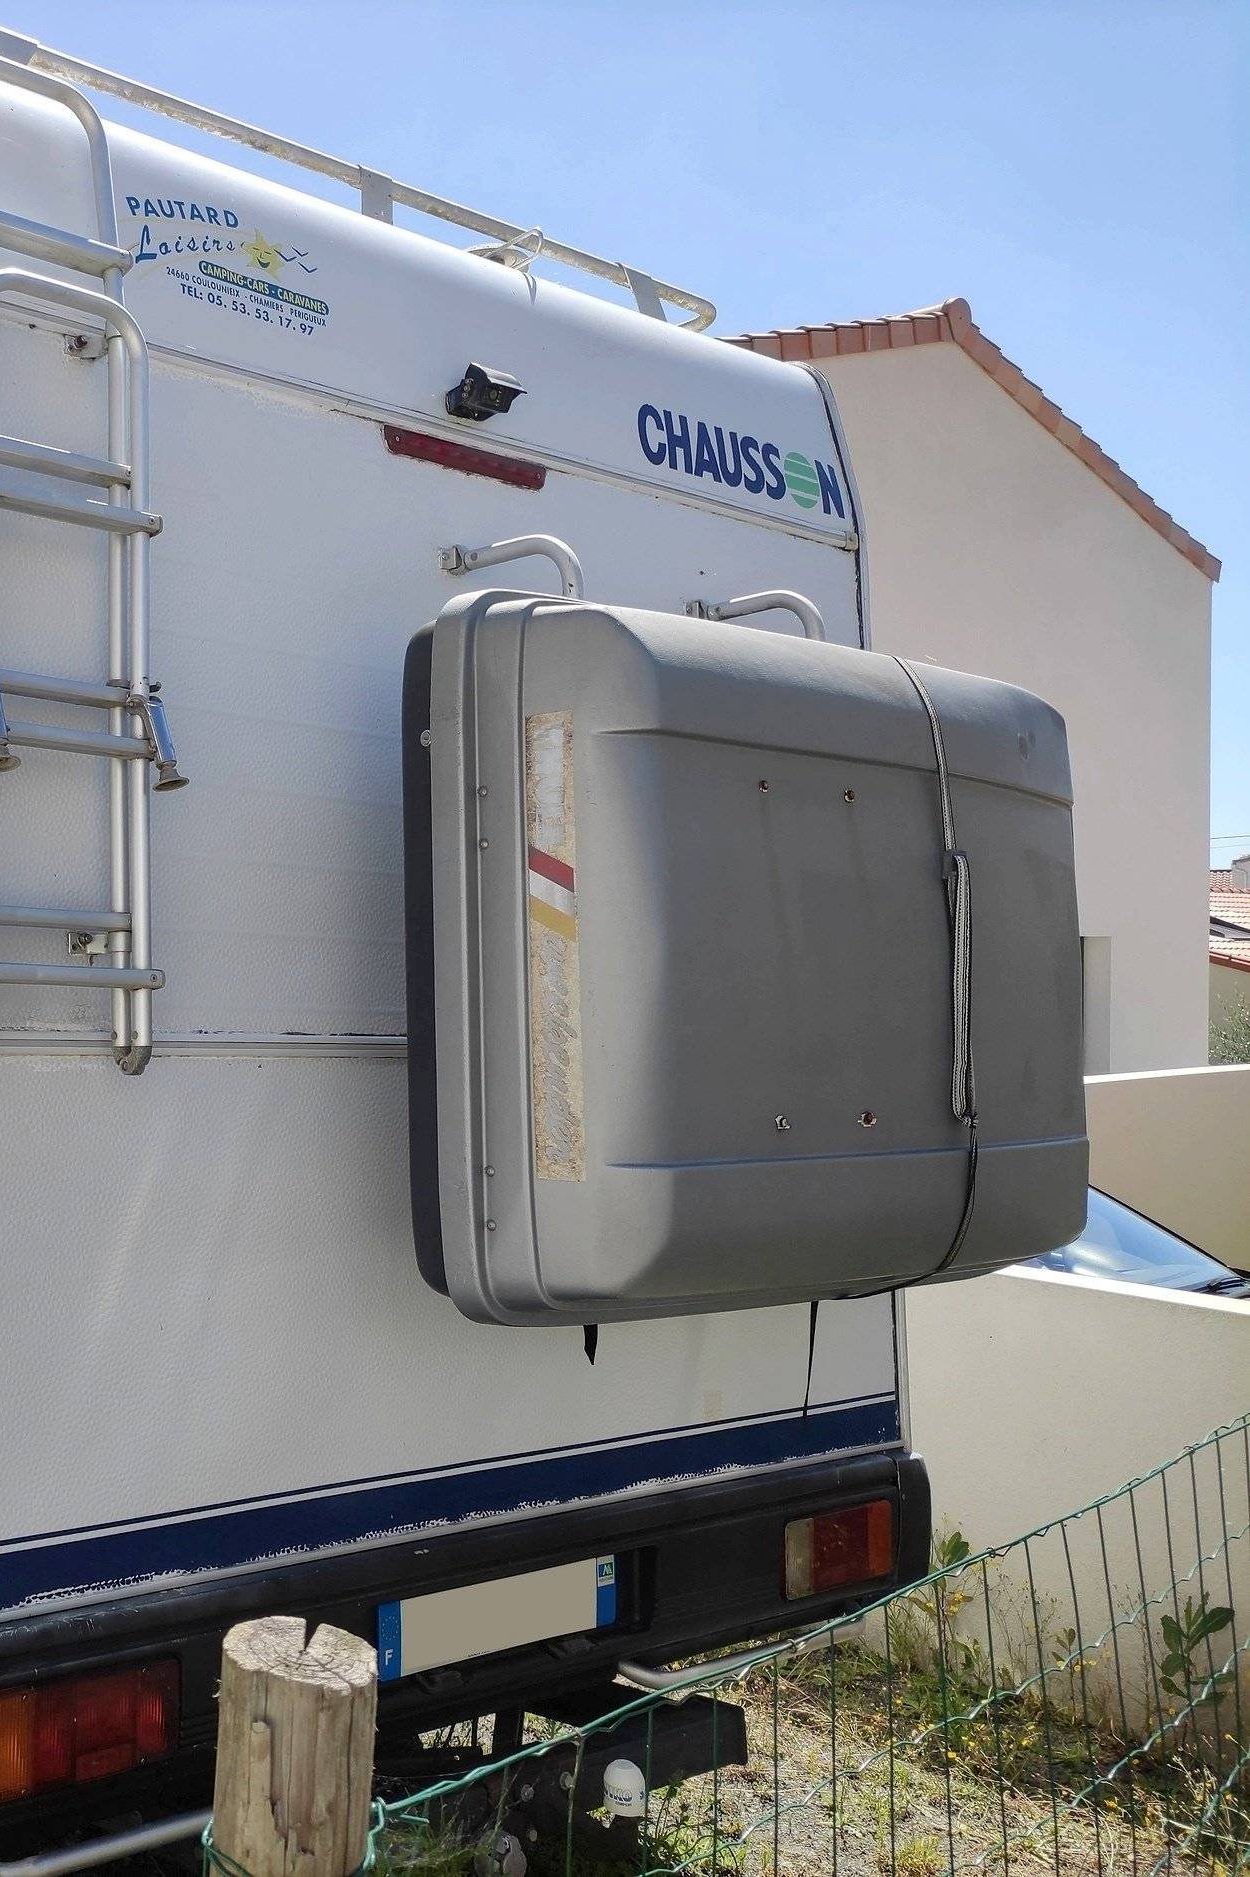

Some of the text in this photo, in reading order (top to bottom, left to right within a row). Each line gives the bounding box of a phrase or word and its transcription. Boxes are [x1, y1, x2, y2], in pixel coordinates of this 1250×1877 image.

[125, 196, 239, 228] PAUTARD
[135, 224, 236, 264] Loisirs
[166, 266, 190, 281] 24660
[249, 294, 284, 313] CHAMIERS
[290, 307, 327, 327] PERIGUEUX
[180, 283, 203, 300] TEL:
[299, 323, 314, 336] 97
[201, 261, 326, 315] CAMPING-CARS CARAVANES
[638, 404, 846, 519] CHAUSSON
[386, 1650, 394, 1666] F
